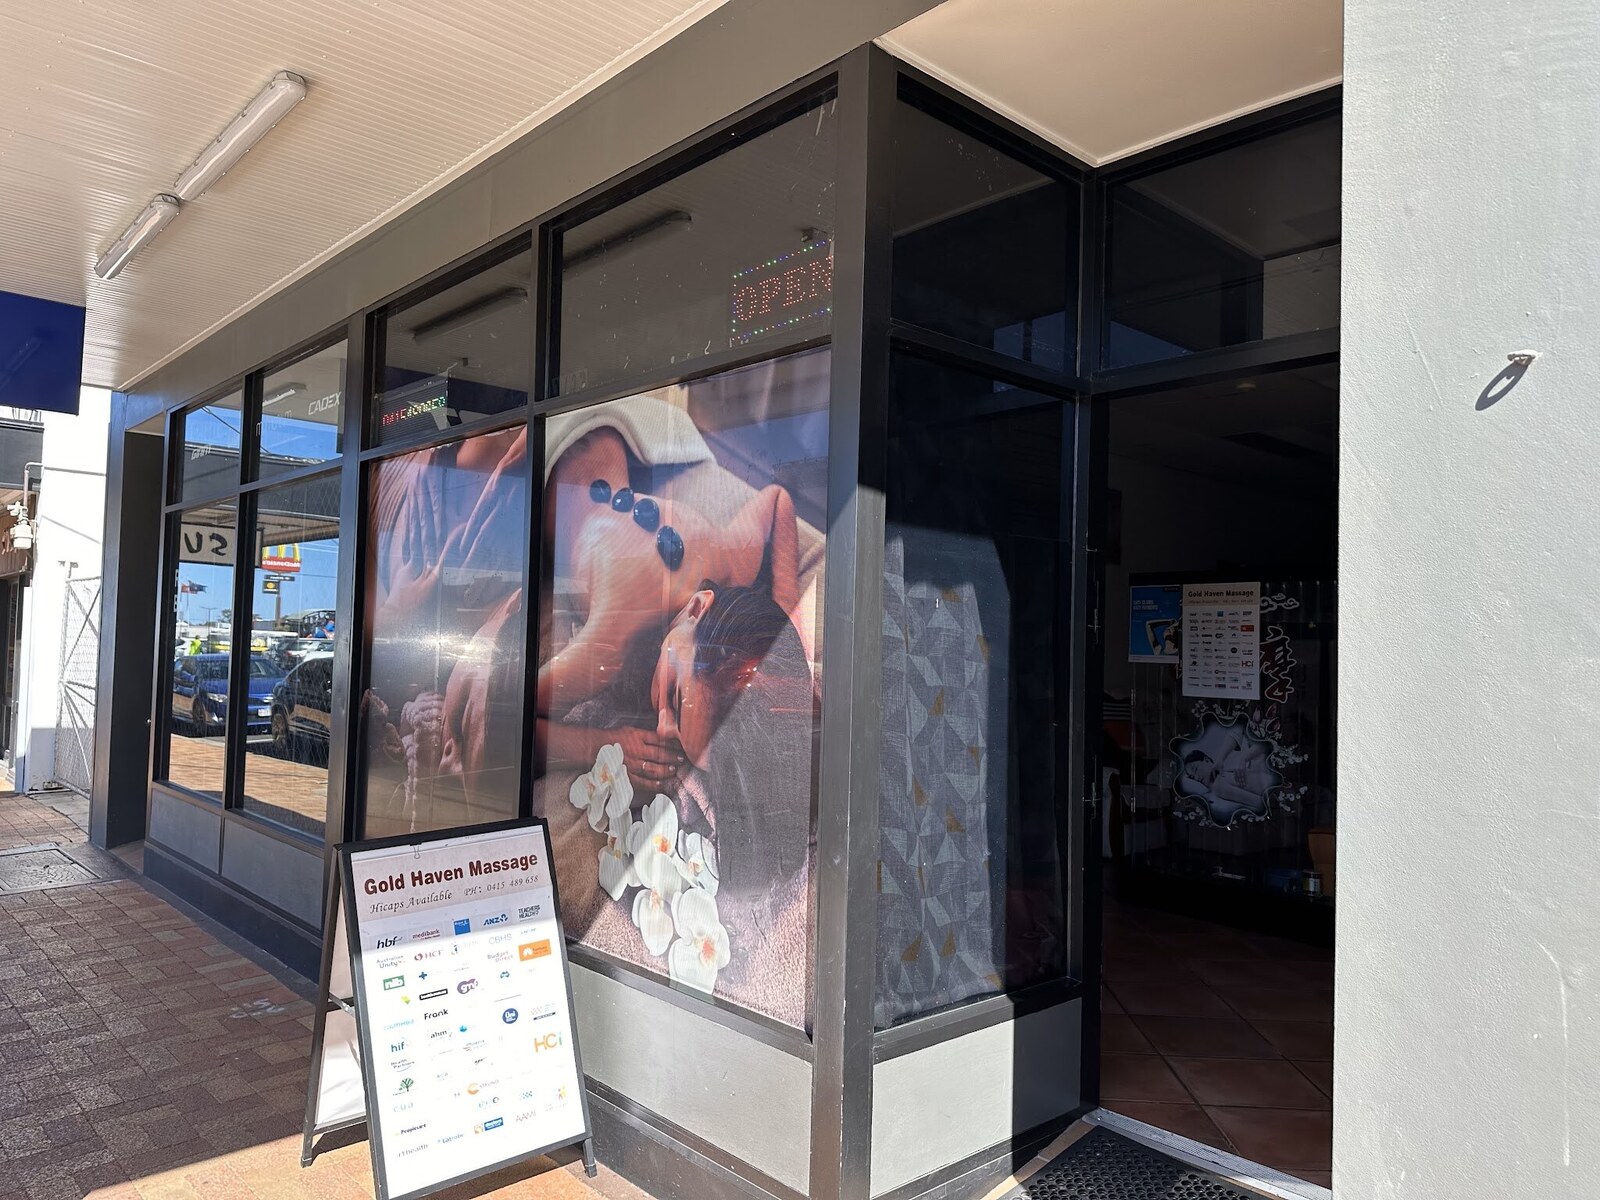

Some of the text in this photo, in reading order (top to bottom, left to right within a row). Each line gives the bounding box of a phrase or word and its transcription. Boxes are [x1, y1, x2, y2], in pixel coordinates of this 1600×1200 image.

[737, 256, 833, 320] OPEN
[308, 391, 342, 416] CADEX
[1226, 590, 1254, 598] Massage
[364, 853, 538, 895] Gold Haven Massage
[370, 899, 404, 914] Hicaps
[406, 890, 453, 909] Available
[486, 881, 505, 892] 0415
[509, 878, 523, 889] 489
[525, 875, 539, 885] 658
[483, 916, 501, 927] ANZ
[412, 928, 440, 940] medibank
[488, 933, 513, 945] CBHS
[376, 936, 401, 949] hbf
[424, 1009, 449, 1020] Frank
[430, 1029, 447, 1039] ahm
[391, 1042, 405, 1053] hif
